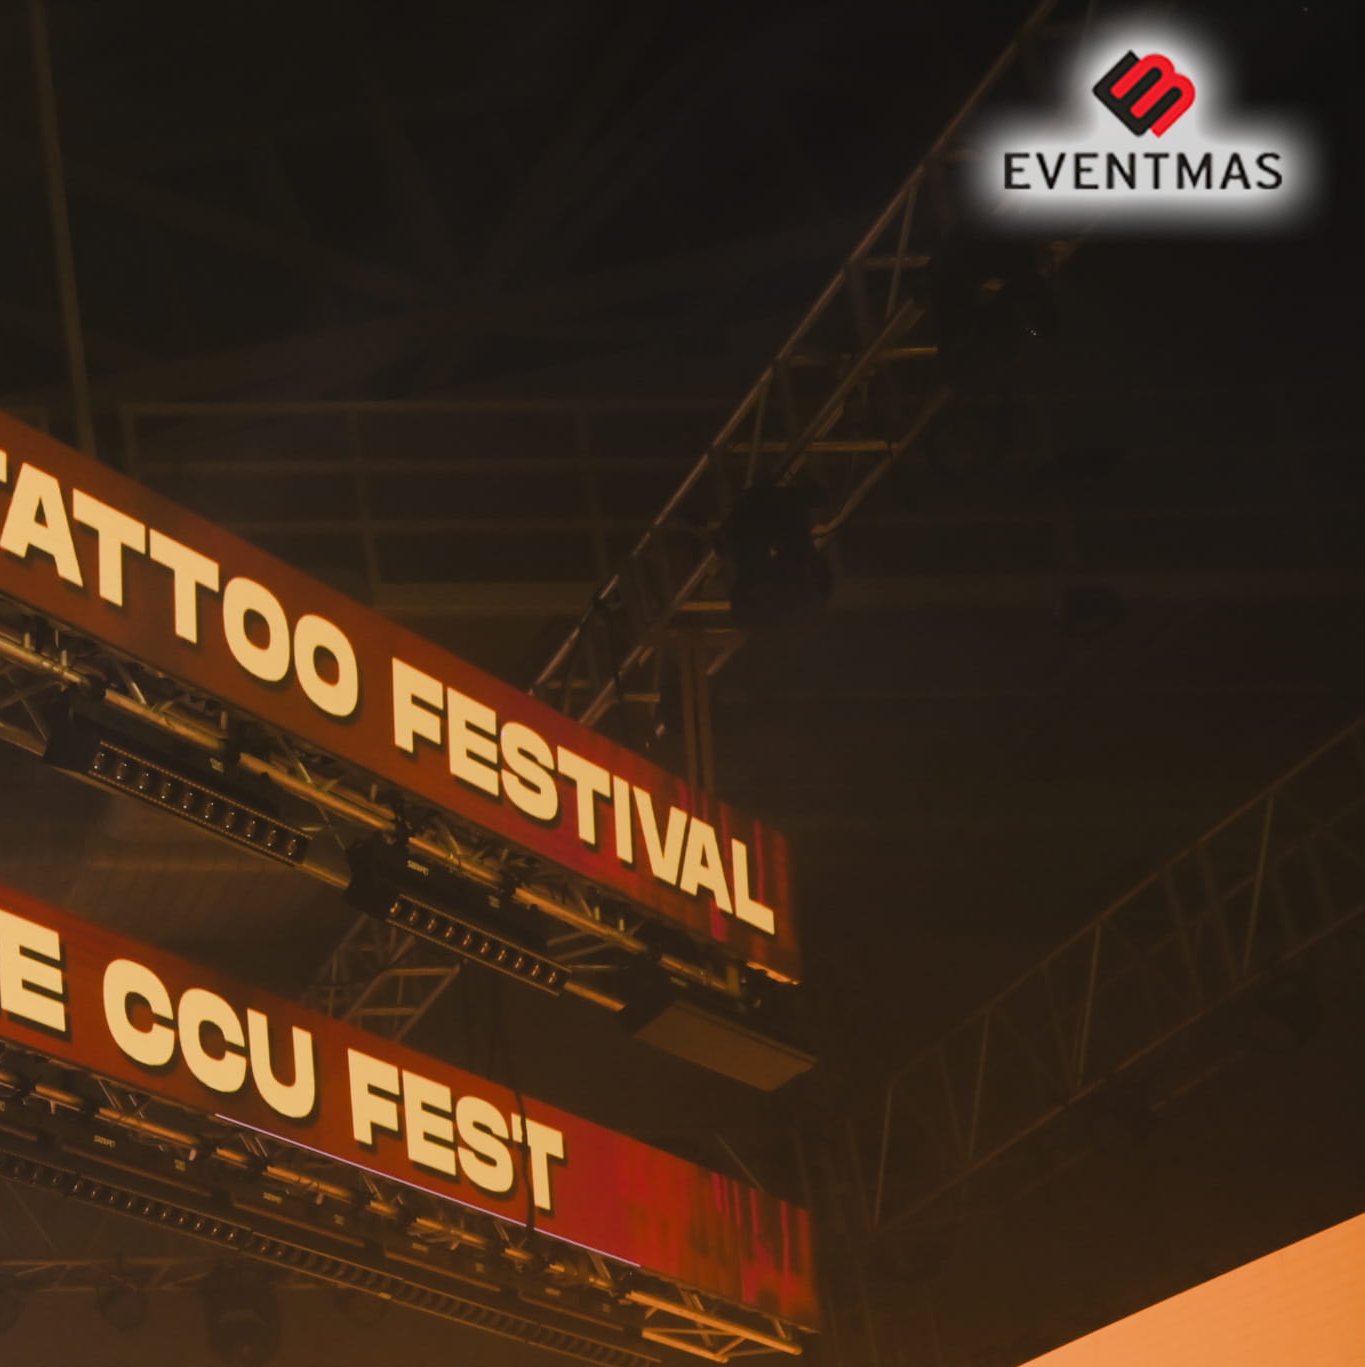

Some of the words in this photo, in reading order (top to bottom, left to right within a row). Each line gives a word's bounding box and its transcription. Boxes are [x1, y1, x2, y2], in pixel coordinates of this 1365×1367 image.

[392, 657, 776, 935] FESTIVAL
[102, 957, 316, 1120] CCU
[346, 1047, 565, 1212] FEST
